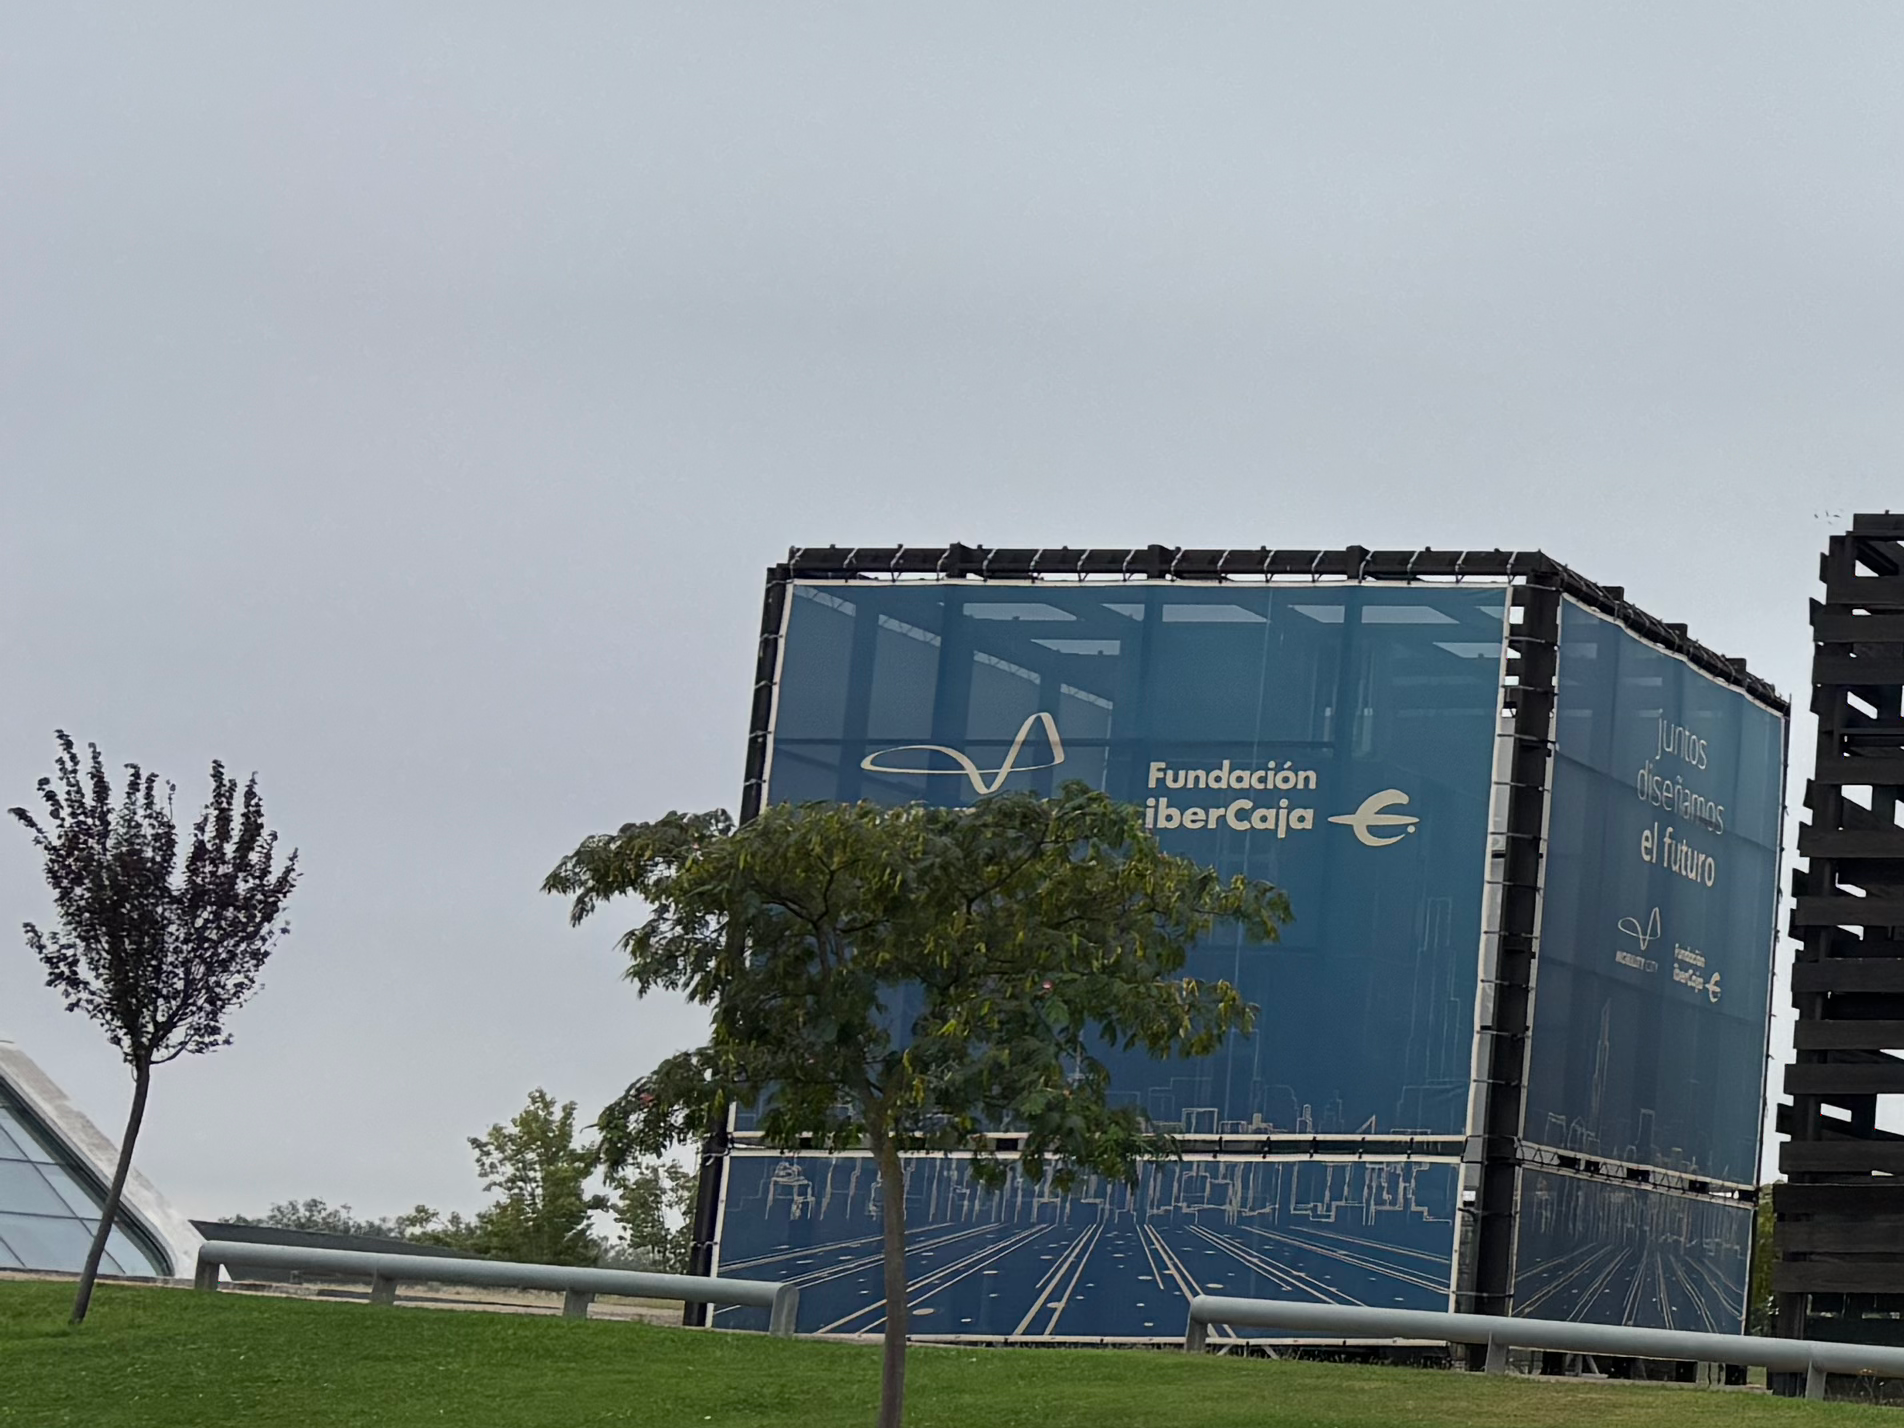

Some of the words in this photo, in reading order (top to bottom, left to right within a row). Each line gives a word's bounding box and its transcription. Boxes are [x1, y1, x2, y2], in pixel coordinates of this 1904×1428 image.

[1655, 708, 1707, 769] juntos
[1149, 759, 1317, 790] Fundación
[1637, 760, 1724, 835] diseñamos
[1145, 797, 1314, 839] iberCaja
[1641, 822, 1658, 863] el
[1663, 827, 1715, 887] futuro
